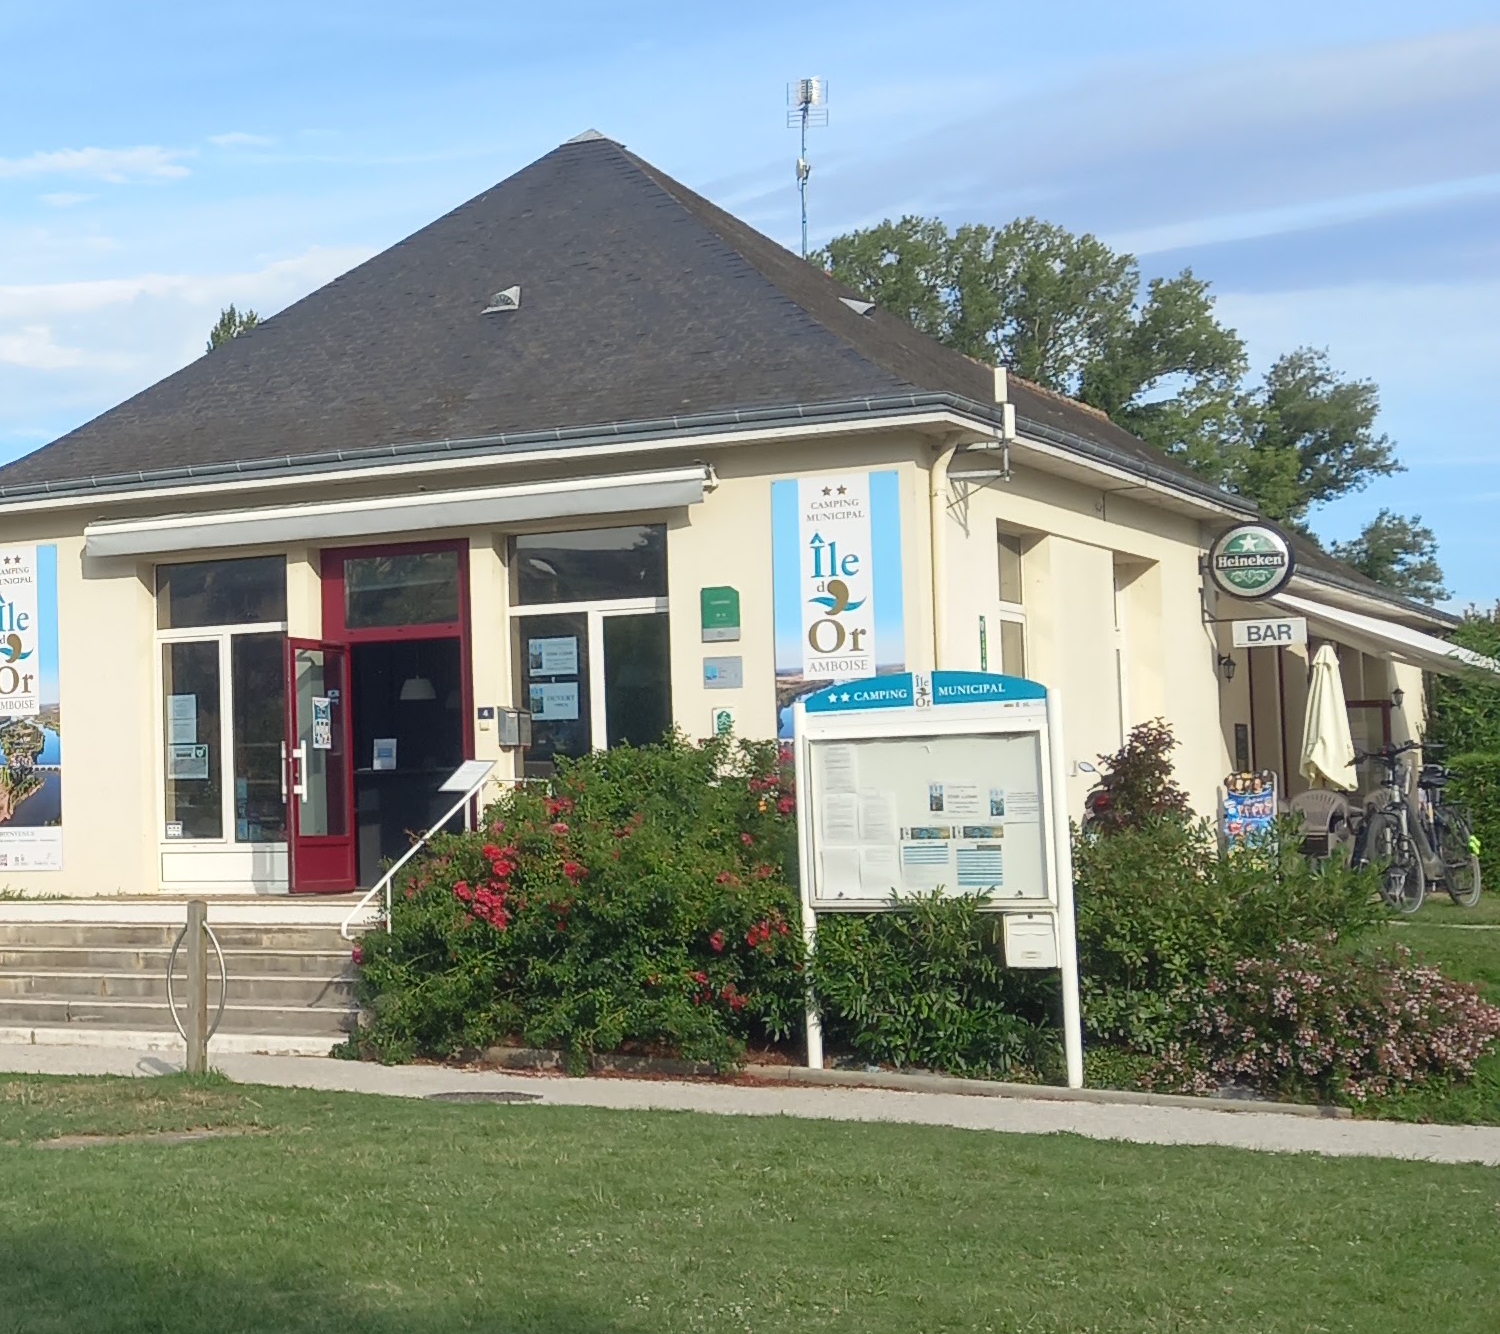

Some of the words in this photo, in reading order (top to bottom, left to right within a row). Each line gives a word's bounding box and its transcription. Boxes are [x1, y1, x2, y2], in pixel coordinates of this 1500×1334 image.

[810, 498, 859, 510] CAMPING
[806, 510, 865, 522] MUNICIPAL
[809, 532, 859, 578] Île
[1218, 555, 1282, 567] Heineken
[808, 618, 867, 654] Or
[1246, 624, 1292, 642] BAR
[808, 659, 869, 672] AMBOISE
[853, 689, 908, 702] CAMPING
[938, 683, 1006, 696] MUNICIPAL
[915, 697, 931, 708] Or
